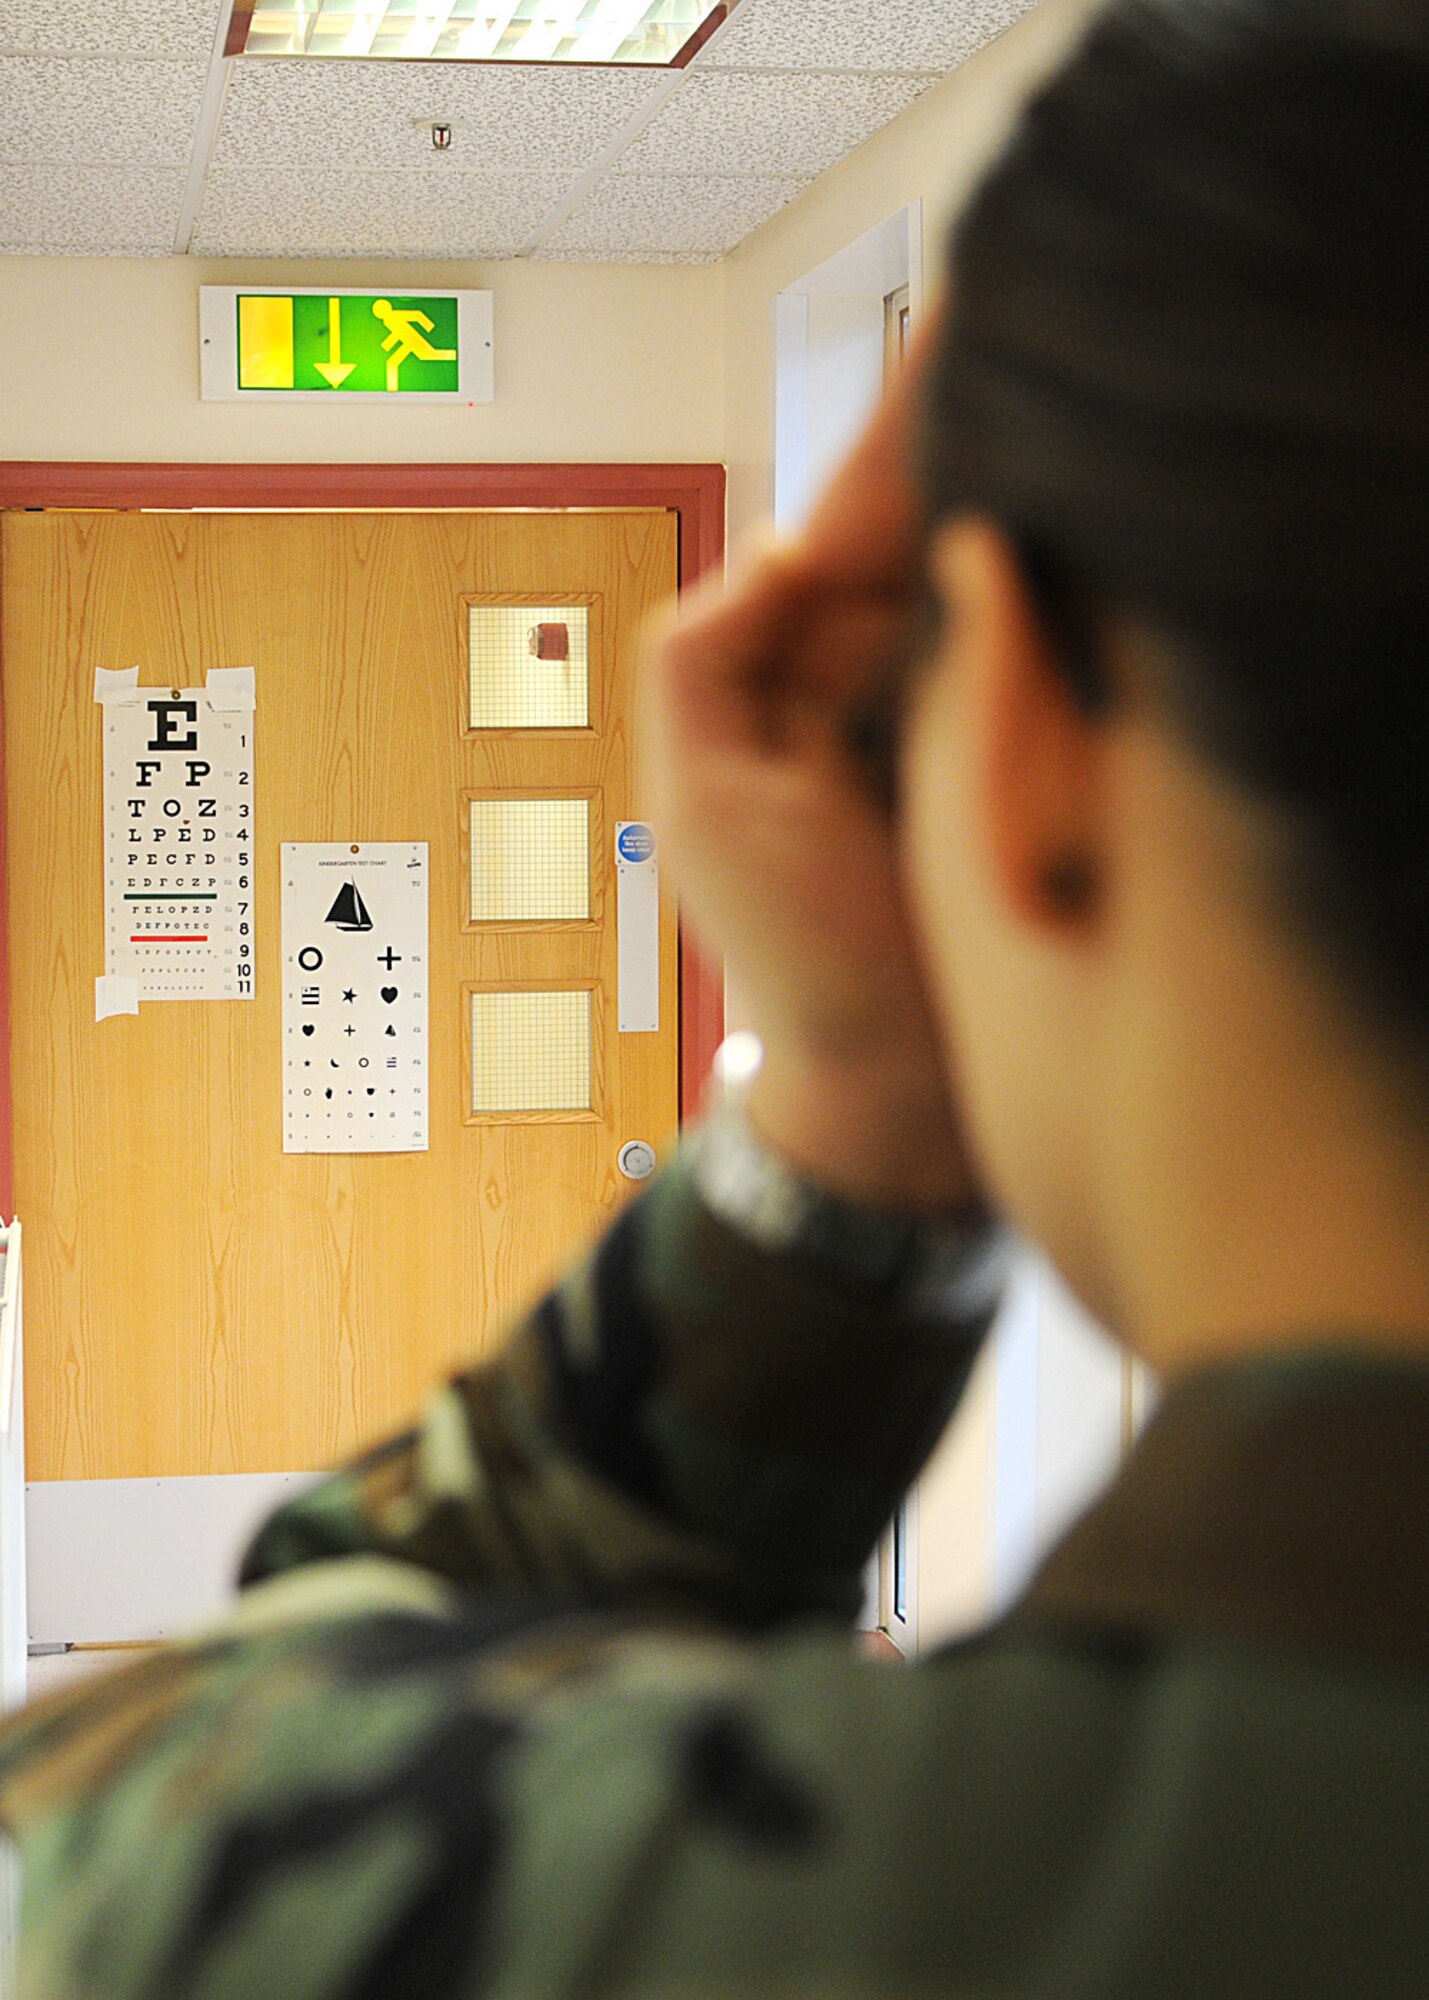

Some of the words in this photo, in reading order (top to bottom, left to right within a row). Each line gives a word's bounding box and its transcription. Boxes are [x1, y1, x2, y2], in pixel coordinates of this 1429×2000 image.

[148, 701, 197, 751] E
[241, 735, 246, 748] 1
[238, 772, 249, 785] 2
[239, 804, 250, 818] 3
[236, 828, 249, 842] 4
[238, 852, 249, 866] 5
[238, 875, 249, 889] 6
[237, 902, 249, 916] 7
[239, 922, 250, 936] 8
[239, 944, 250, 958] 9
[237, 963, 251, 977] 10
[238, 980, 251, 994] 11
